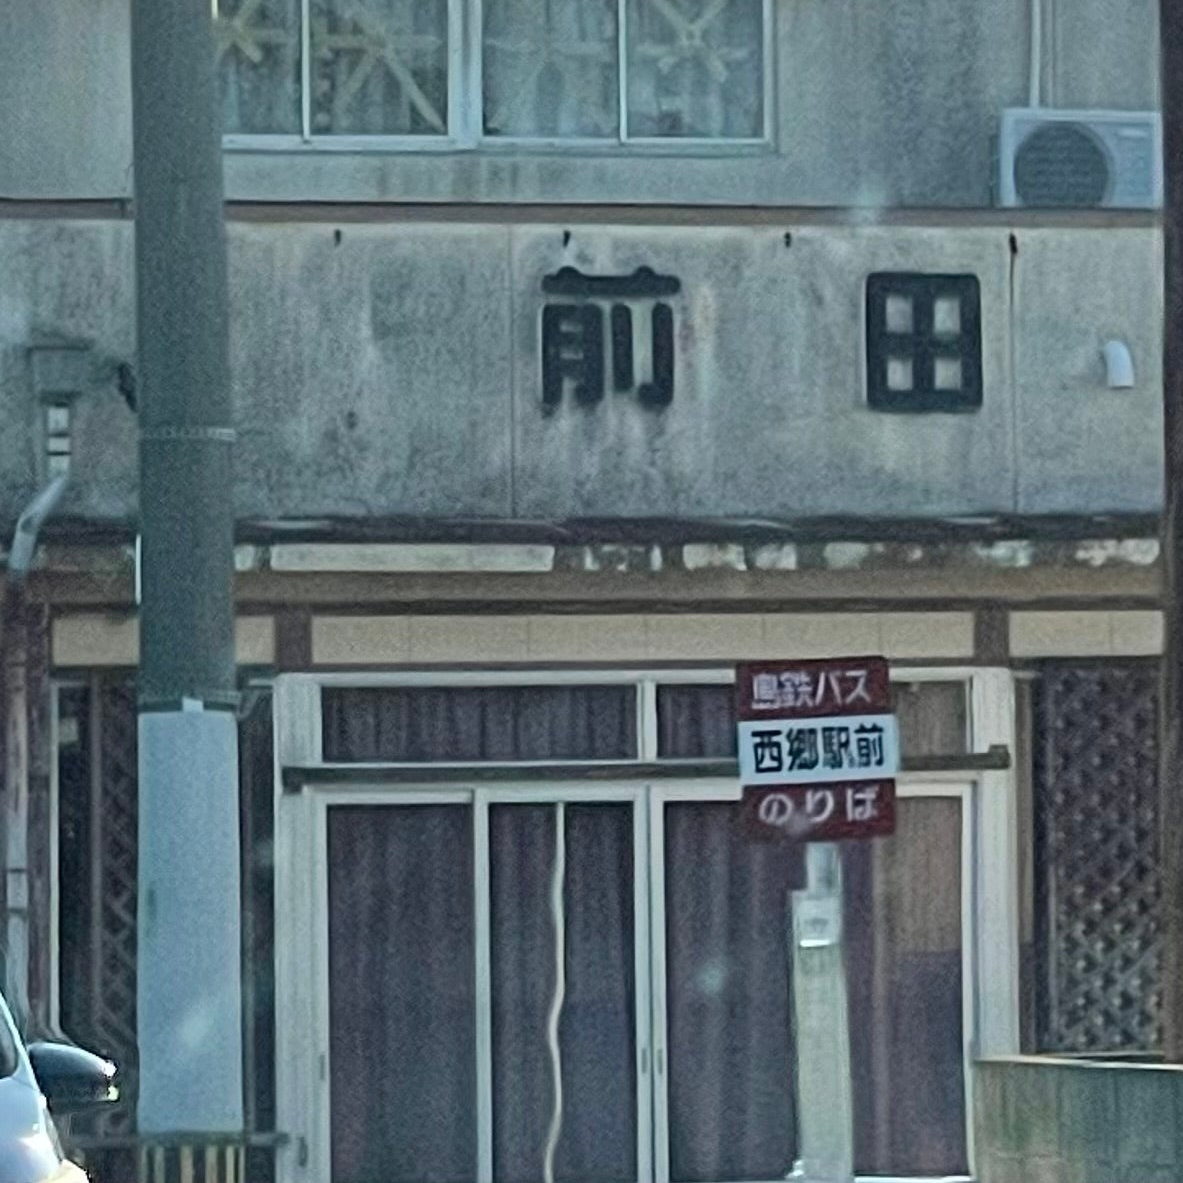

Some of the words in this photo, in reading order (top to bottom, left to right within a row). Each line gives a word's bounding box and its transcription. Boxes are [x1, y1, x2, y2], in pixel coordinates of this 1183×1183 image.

[751, 724, 884, 773] 西郷駅前
[759, 785, 881, 825] のりば
